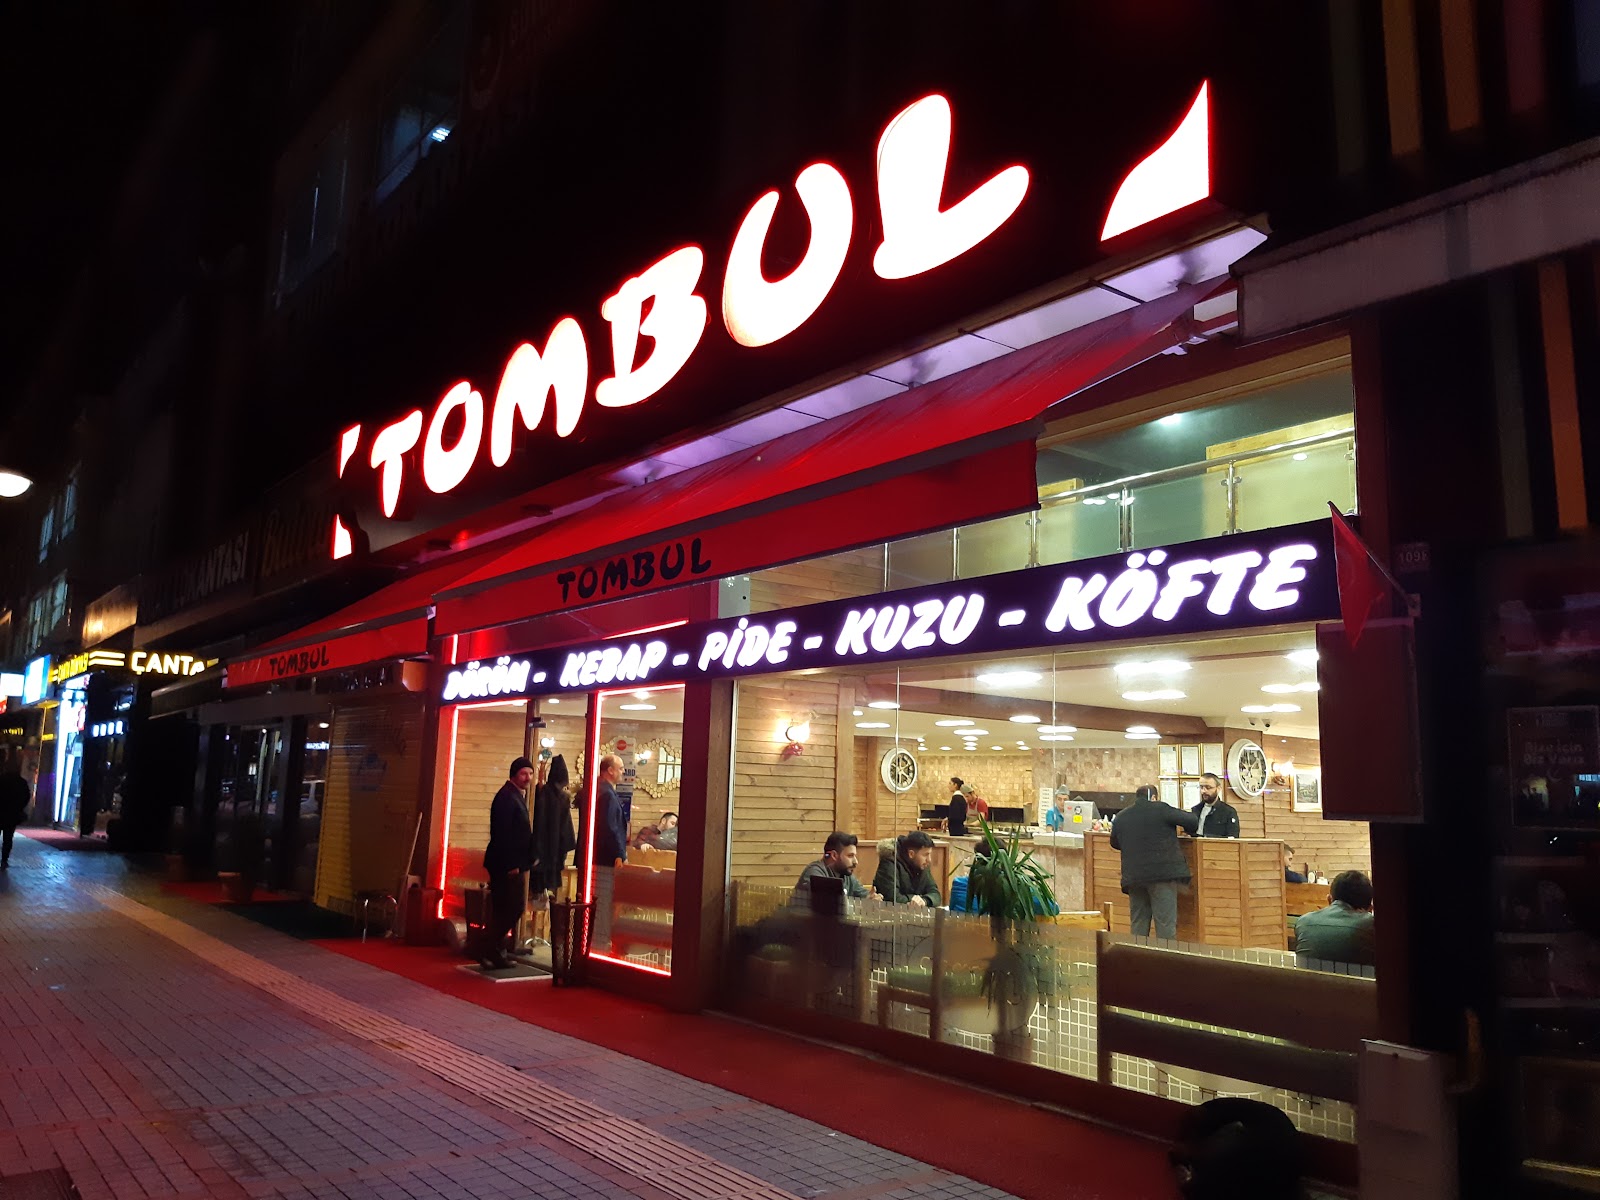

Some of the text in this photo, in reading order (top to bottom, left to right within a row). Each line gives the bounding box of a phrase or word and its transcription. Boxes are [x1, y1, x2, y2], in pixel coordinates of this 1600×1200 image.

[370, 94, 1030, 518] TOMBUL
[557, 538, 712, 603] TOMBUL
[559, 641, 668, 688] KEBAP
[697, 618, 797, 672] PİDE
[834, 594, 985, 656] KUZU
[1044, 544, 1318, 633] KÖFTE
[269, 645, 330, 677] TOMBUL
